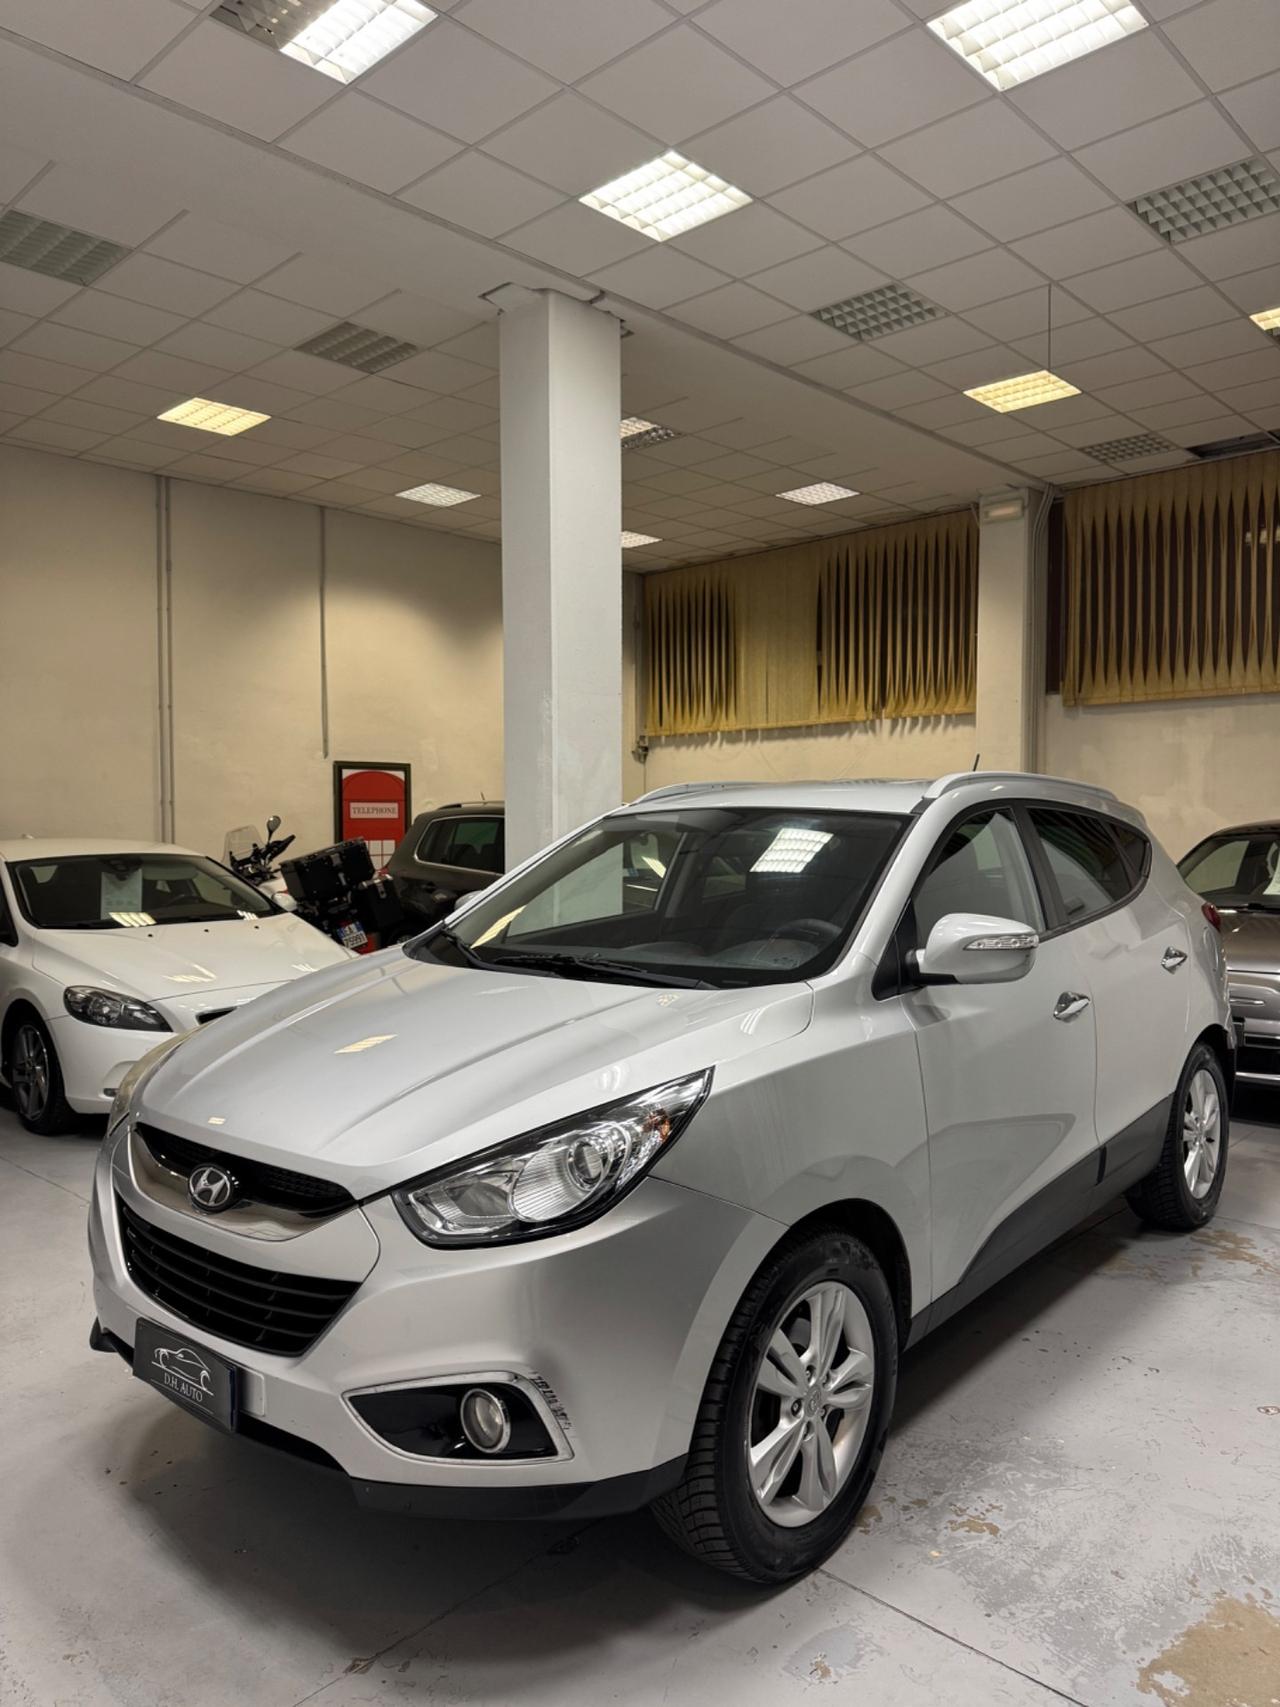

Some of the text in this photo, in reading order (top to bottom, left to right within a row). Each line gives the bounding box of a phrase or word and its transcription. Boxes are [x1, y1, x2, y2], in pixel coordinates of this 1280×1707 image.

[352, 806, 397, 816] TELEPHONE
[164, 1373, 203, 1402] D.H. AUTO
